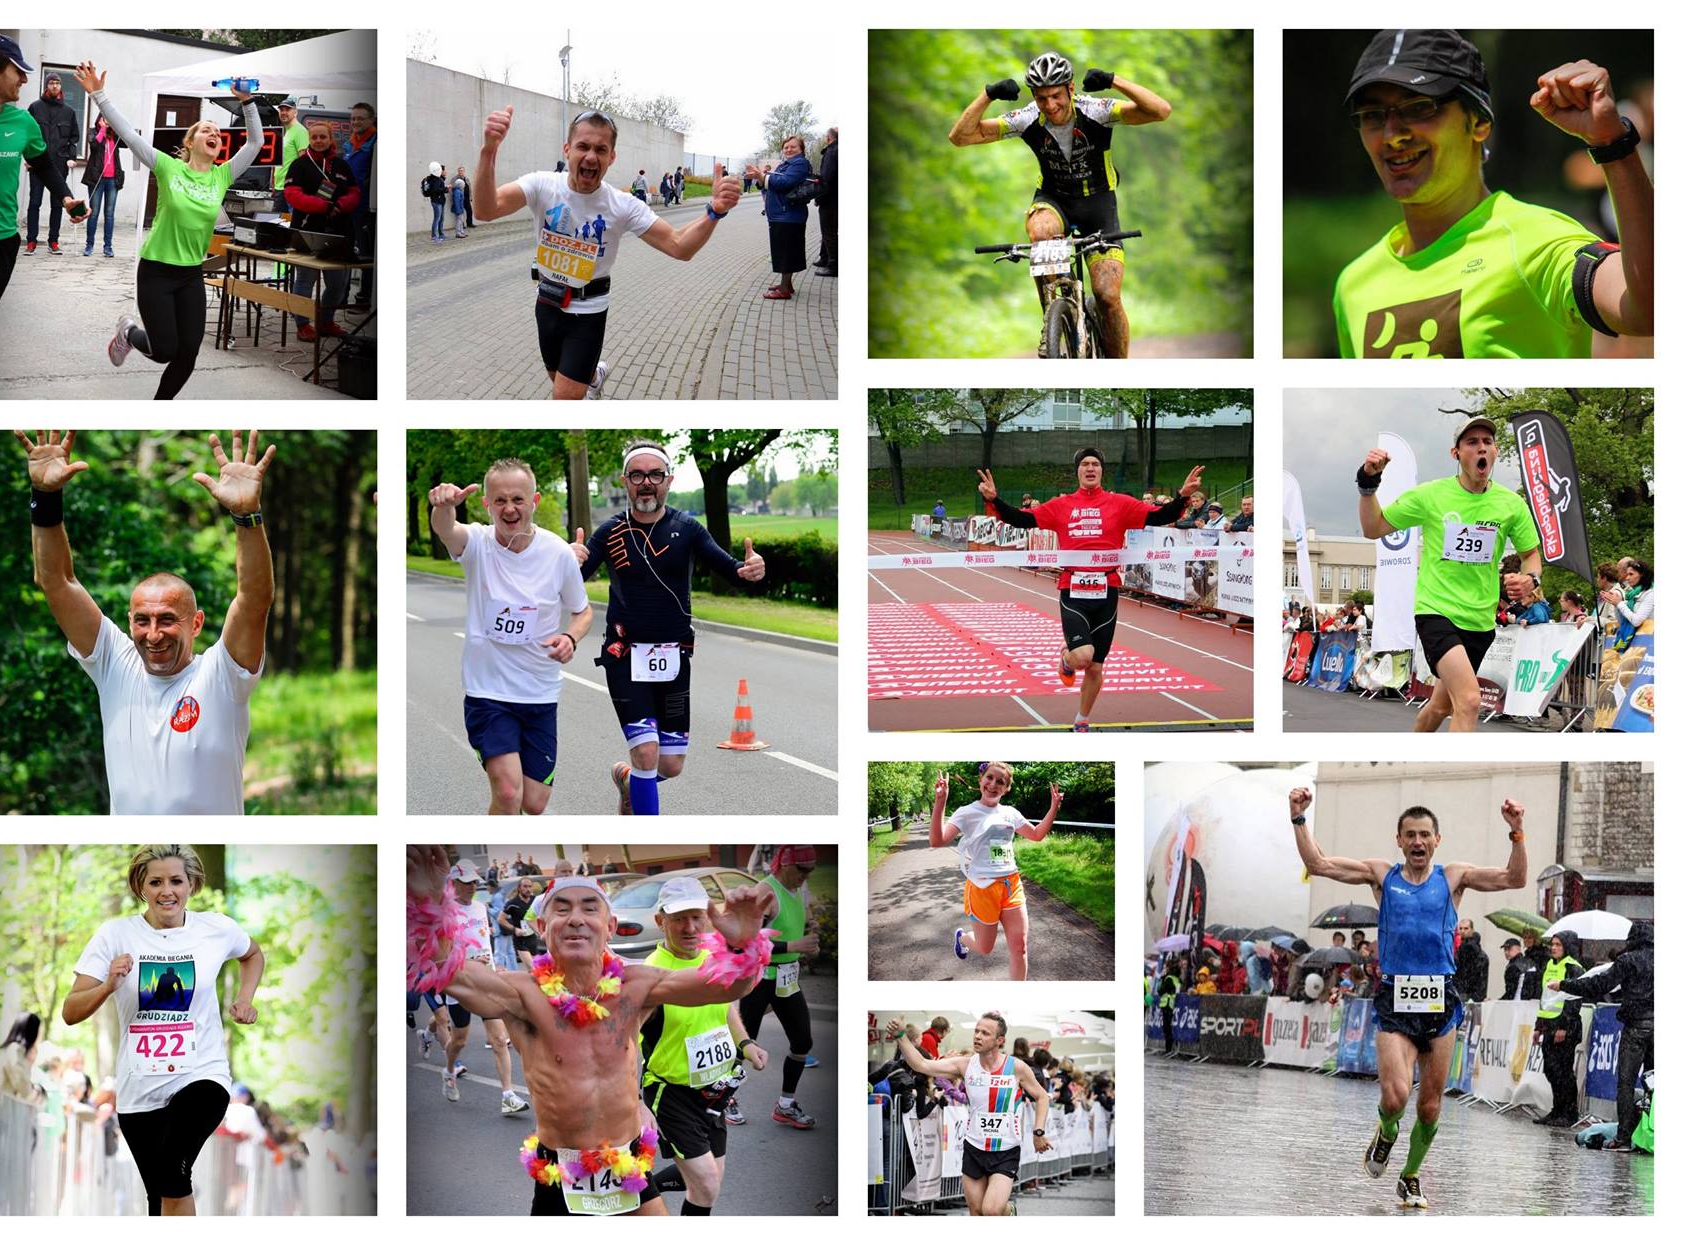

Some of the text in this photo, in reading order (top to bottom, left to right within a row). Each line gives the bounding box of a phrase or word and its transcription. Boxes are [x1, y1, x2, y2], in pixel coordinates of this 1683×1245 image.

[543, 251, 580, 276] 1081
[1455, 538, 1483, 552] 239
[1079, 578, 1099, 588] 915
[494, 616, 525, 634] 509
[649, 658, 667, 671] 60
[1400, 987, 1439, 999] 5208
[137, 1012, 189, 1022] GRUDZIĄDZ
[136, 1033, 186, 1058] 422
[696, 1041, 732, 1069] 2188
[980, 1118, 1003, 1129] 347
